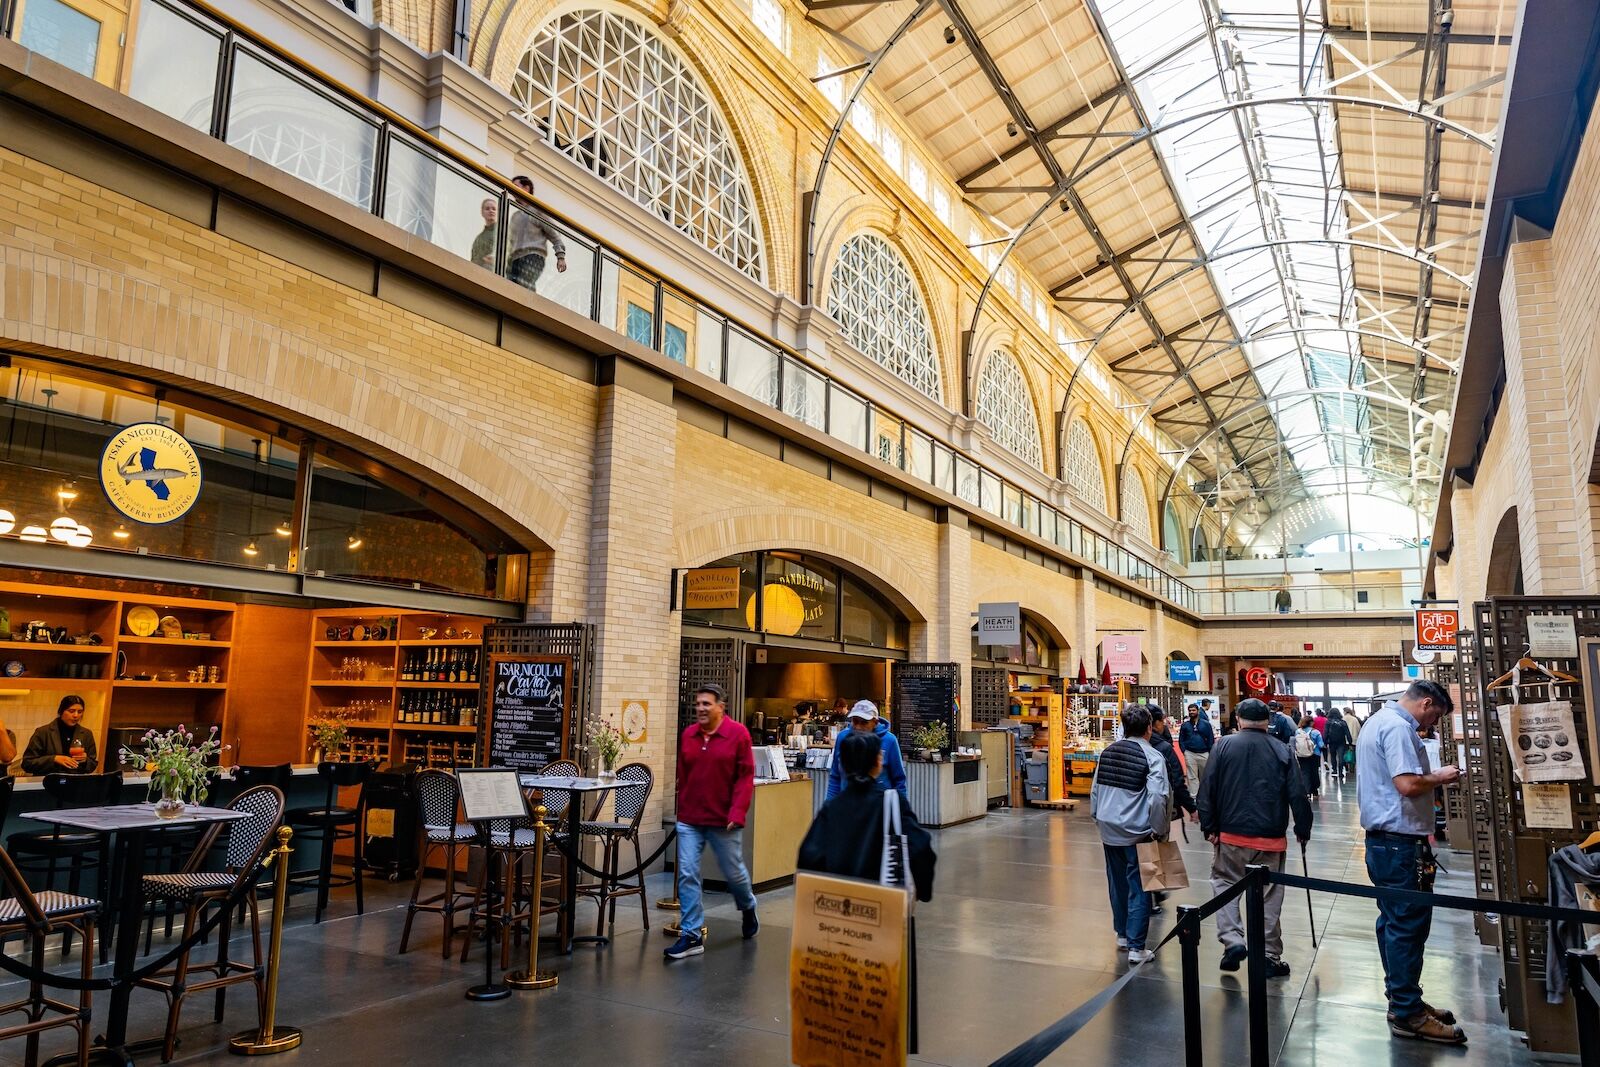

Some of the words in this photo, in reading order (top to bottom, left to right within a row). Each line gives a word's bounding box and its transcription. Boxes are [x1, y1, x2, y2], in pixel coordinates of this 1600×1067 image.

[108, 438, 127, 461] TSAR
[127, 428, 178, 445] NICOULAI
[178, 442, 198, 478] CAVIAR
[124, 503, 152, 519] FERRY
[157, 495, 192, 519] BUILDING
[689, 575, 736, 586] DANDELION
[688, 590, 735, 602] CHOCOLATE
[1421, 612, 1455, 627] FATTED
[1422, 626, 1456, 643] CALF
[498, 663, 520, 676] TSAR
[521, 663, 563, 677] NICOULAI
[818, 922, 841, 934] SHOP
[842, 926, 873, 942] HOURS
